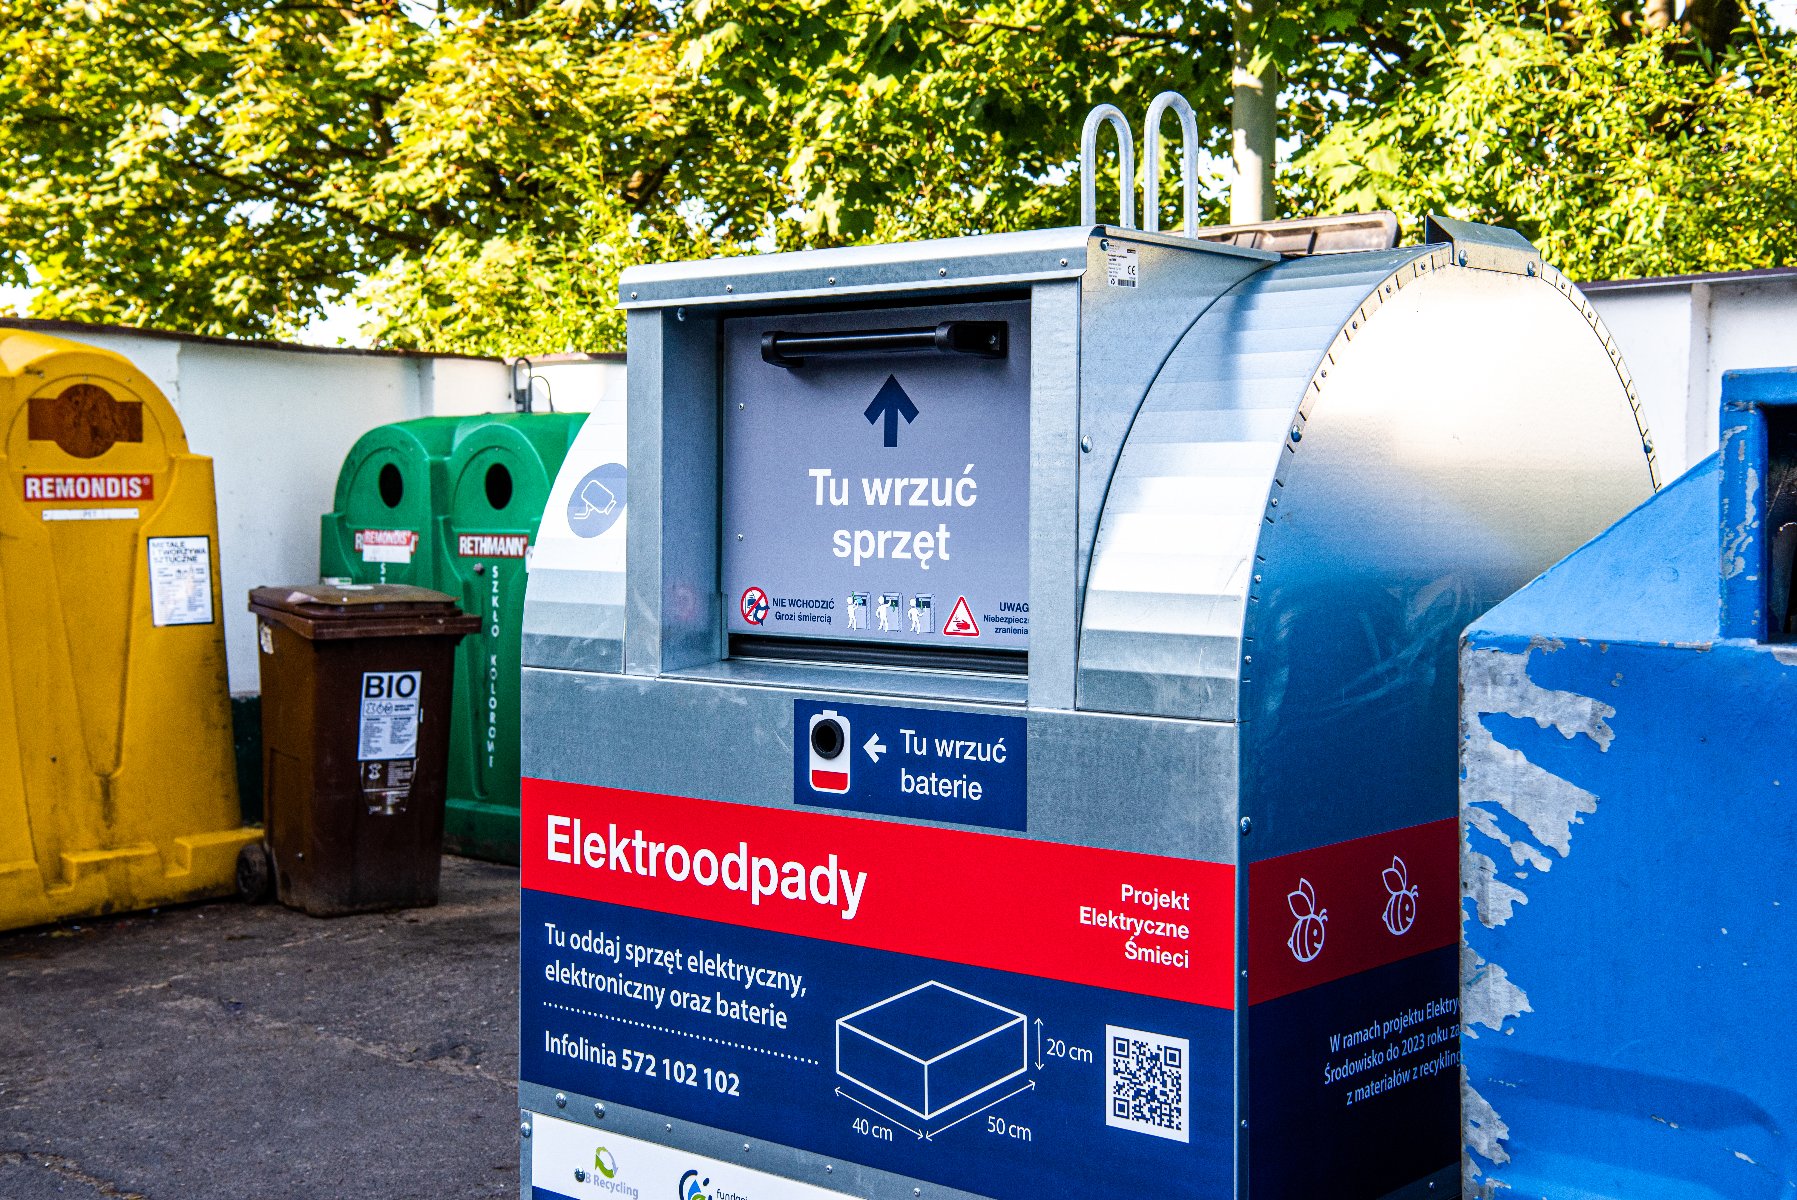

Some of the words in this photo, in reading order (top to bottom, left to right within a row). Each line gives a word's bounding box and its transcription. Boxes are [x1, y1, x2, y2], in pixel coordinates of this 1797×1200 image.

[808, 468, 849, 506] Tu
[862, 463, 978, 507] wrzuć
[832, 523, 950, 570] sprzęt
[772, 598, 787, 608] NIE
[788, 597, 835, 610] WCHODZIĆ
[775, 611, 796, 622] Grozi
[797, 612, 832, 624] śmiercią
[983, 614, 1029, 625] Niebezpiecz
[999, 602, 1029, 613] UWAG
[994, 626, 1029, 635] zranienia
[364, 674, 416, 698] BIO
[900, 728, 926, 755] Tu
[935, 737, 1007, 764] wrzuć
[901, 768, 983, 801] baterie
[547, 814, 868, 920] Elektroodpady
[1121, 883, 1190, 911] Projekt
[1079, 906, 1190, 939] Elektryczne
[544, 922, 565, 948] Tu
[570, 930, 620, 963] oddaj
[625, 943, 683, 975] sprzęt
[688, 950, 807, 998] elektryczny,
[1124, 936, 1190, 968] Śmieci
[545, 960, 666, 1010] elektroniczny
[670, 989, 712, 1014] oraz
[717, 992, 788, 1029] baterie
[1330, 1033, 1341, 1053] W
[1342, 1020, 1381, 1049] ramach
[1383, 1008, 1424, 1039] projektu
[1426, 998, 1460, 1020] Elektry
[546, 1030, 617, 1068] Infolinia
[621, 1049, 657, 1077] 572
[662, 1058, 698, 1087] 102
[703, 1068, 740, 1097] 102
[1046, 1038, 1065, 1058] 20
[1068, 1046, 1093, 1063] cm
[1324, 1050, 1384, 1085] Środowisko
[1386, 1042, 1399, 1062] do
[1402, 1033, 1425, 1056] 2023
[1427, 1026, 1448, 1047] roku
[1346, 1091, 1353, 1106] z
[1354, 1068, 1411, 1102] materiałów
[1412, 1066, 1418, 1080] z
[852, 1117, 869, 1136] 40
[872, 1124, 893, 1142] cm
[987, 1116, 1007, 1135] 50
[1009, 1123, 1032, 1142] cm
[594, 1174, 639, 1200] Recycling
